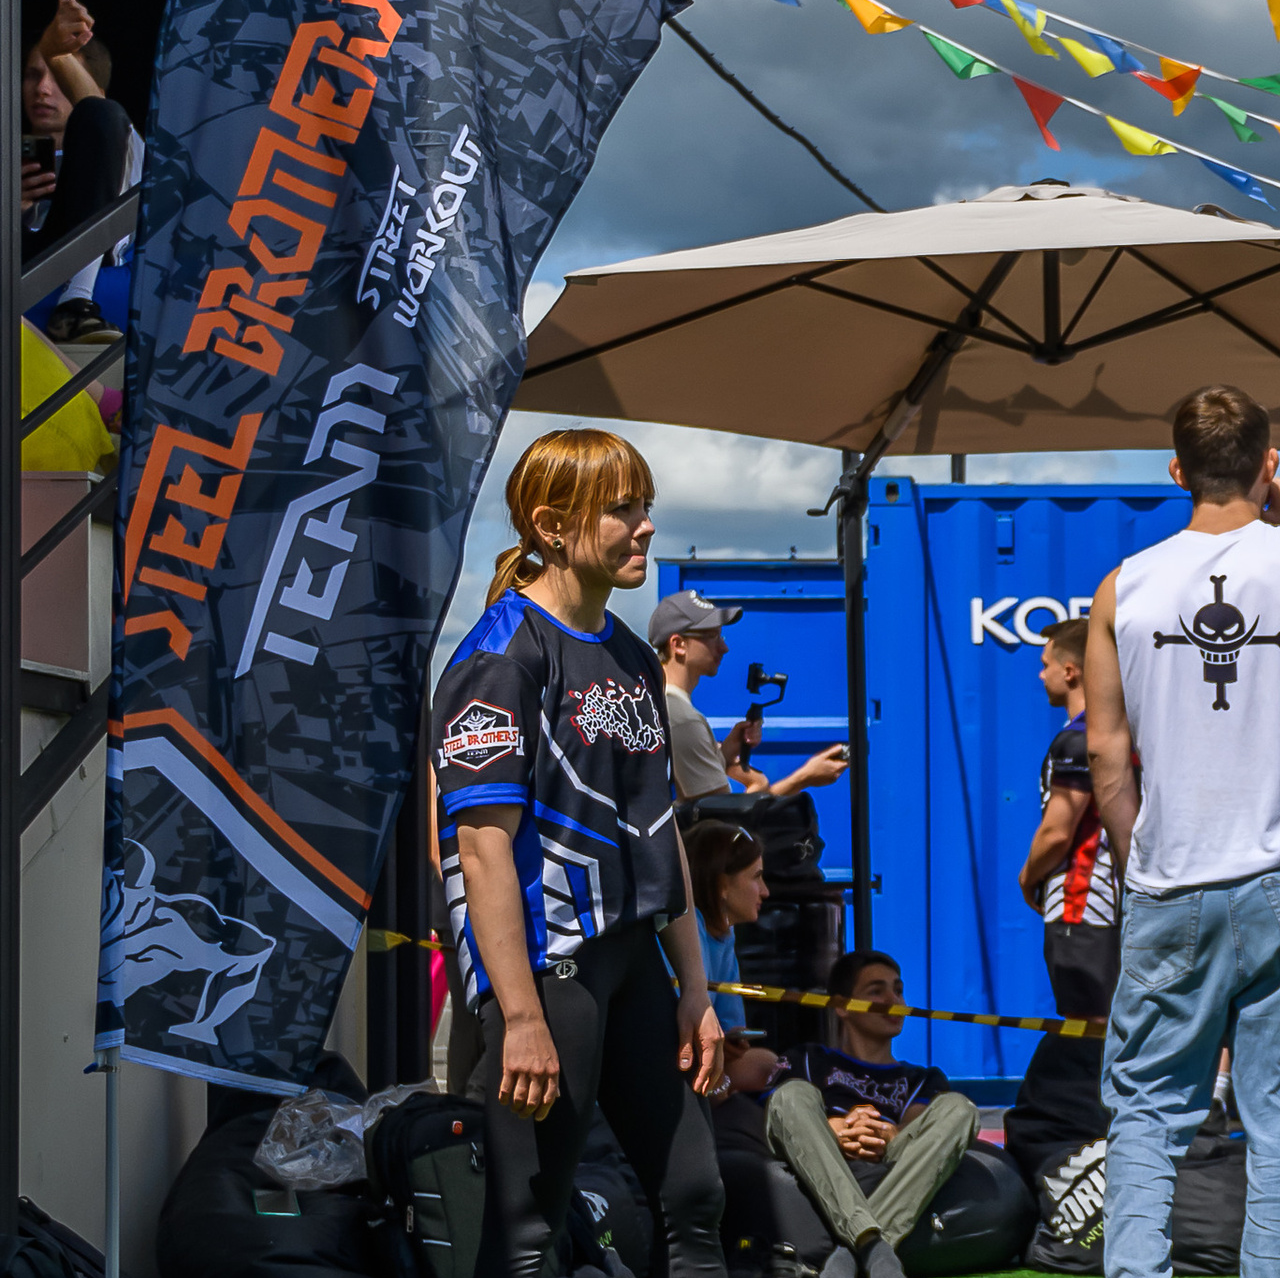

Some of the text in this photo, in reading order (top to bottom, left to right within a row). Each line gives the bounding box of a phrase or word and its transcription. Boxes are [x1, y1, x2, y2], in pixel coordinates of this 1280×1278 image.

[356, 164, 417, 310] STREET
[393, 124, 482, 328] WORKOUT
[235, 363, 400, 679] TEAM
[466, 730, 519, 746] BROTHERS
